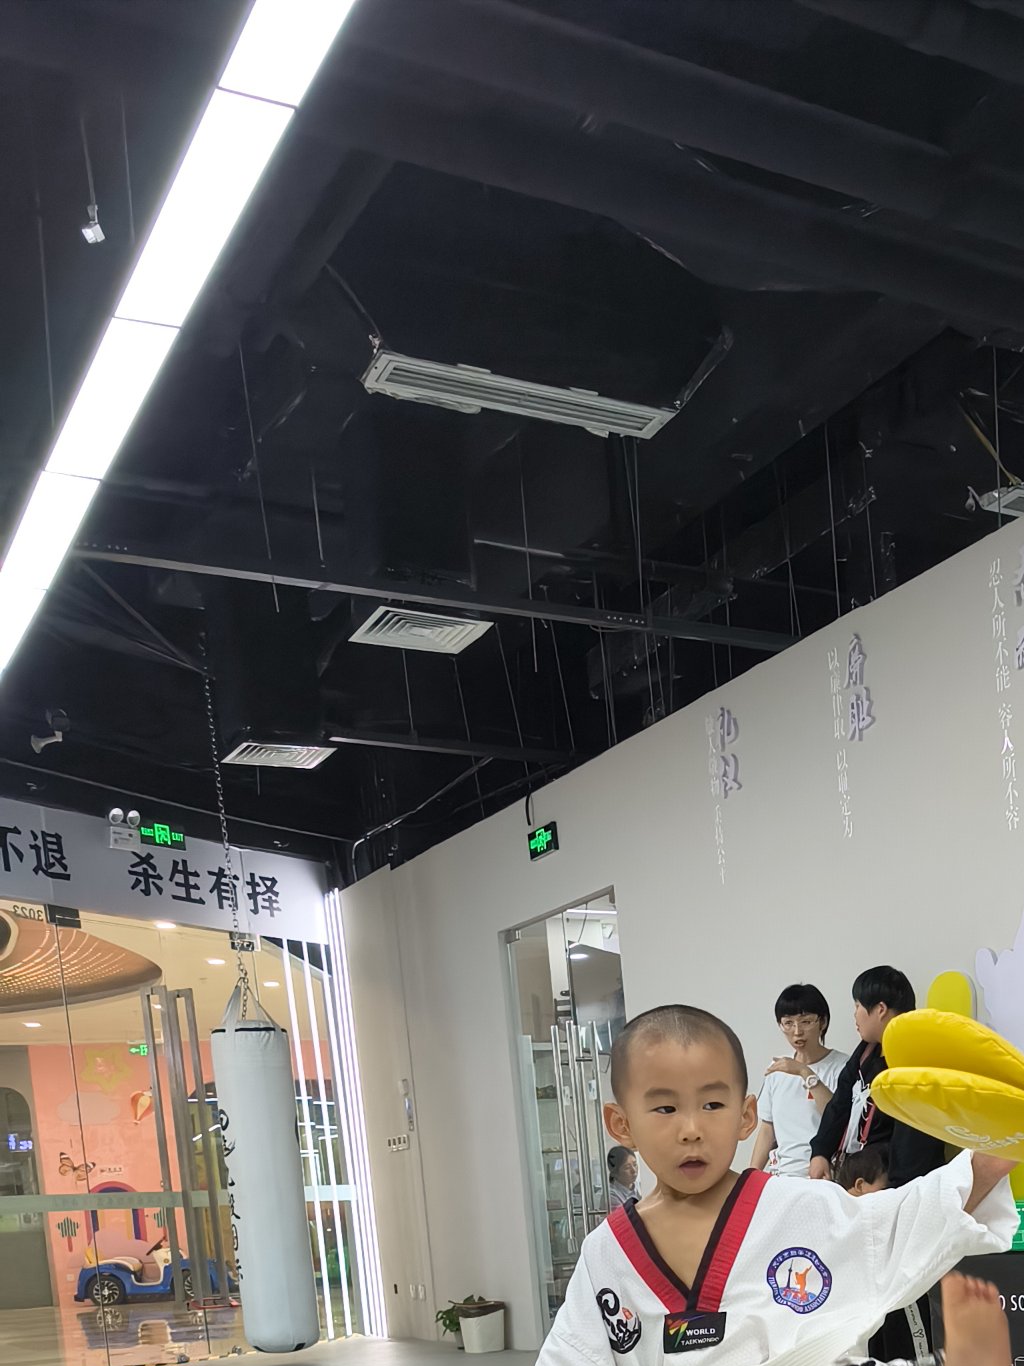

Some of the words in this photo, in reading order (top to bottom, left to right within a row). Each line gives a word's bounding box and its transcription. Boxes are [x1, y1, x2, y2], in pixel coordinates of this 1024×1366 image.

[127, 851, 283, 919] 杀生有择
[685, 1328, 716, 1337] WORLD
